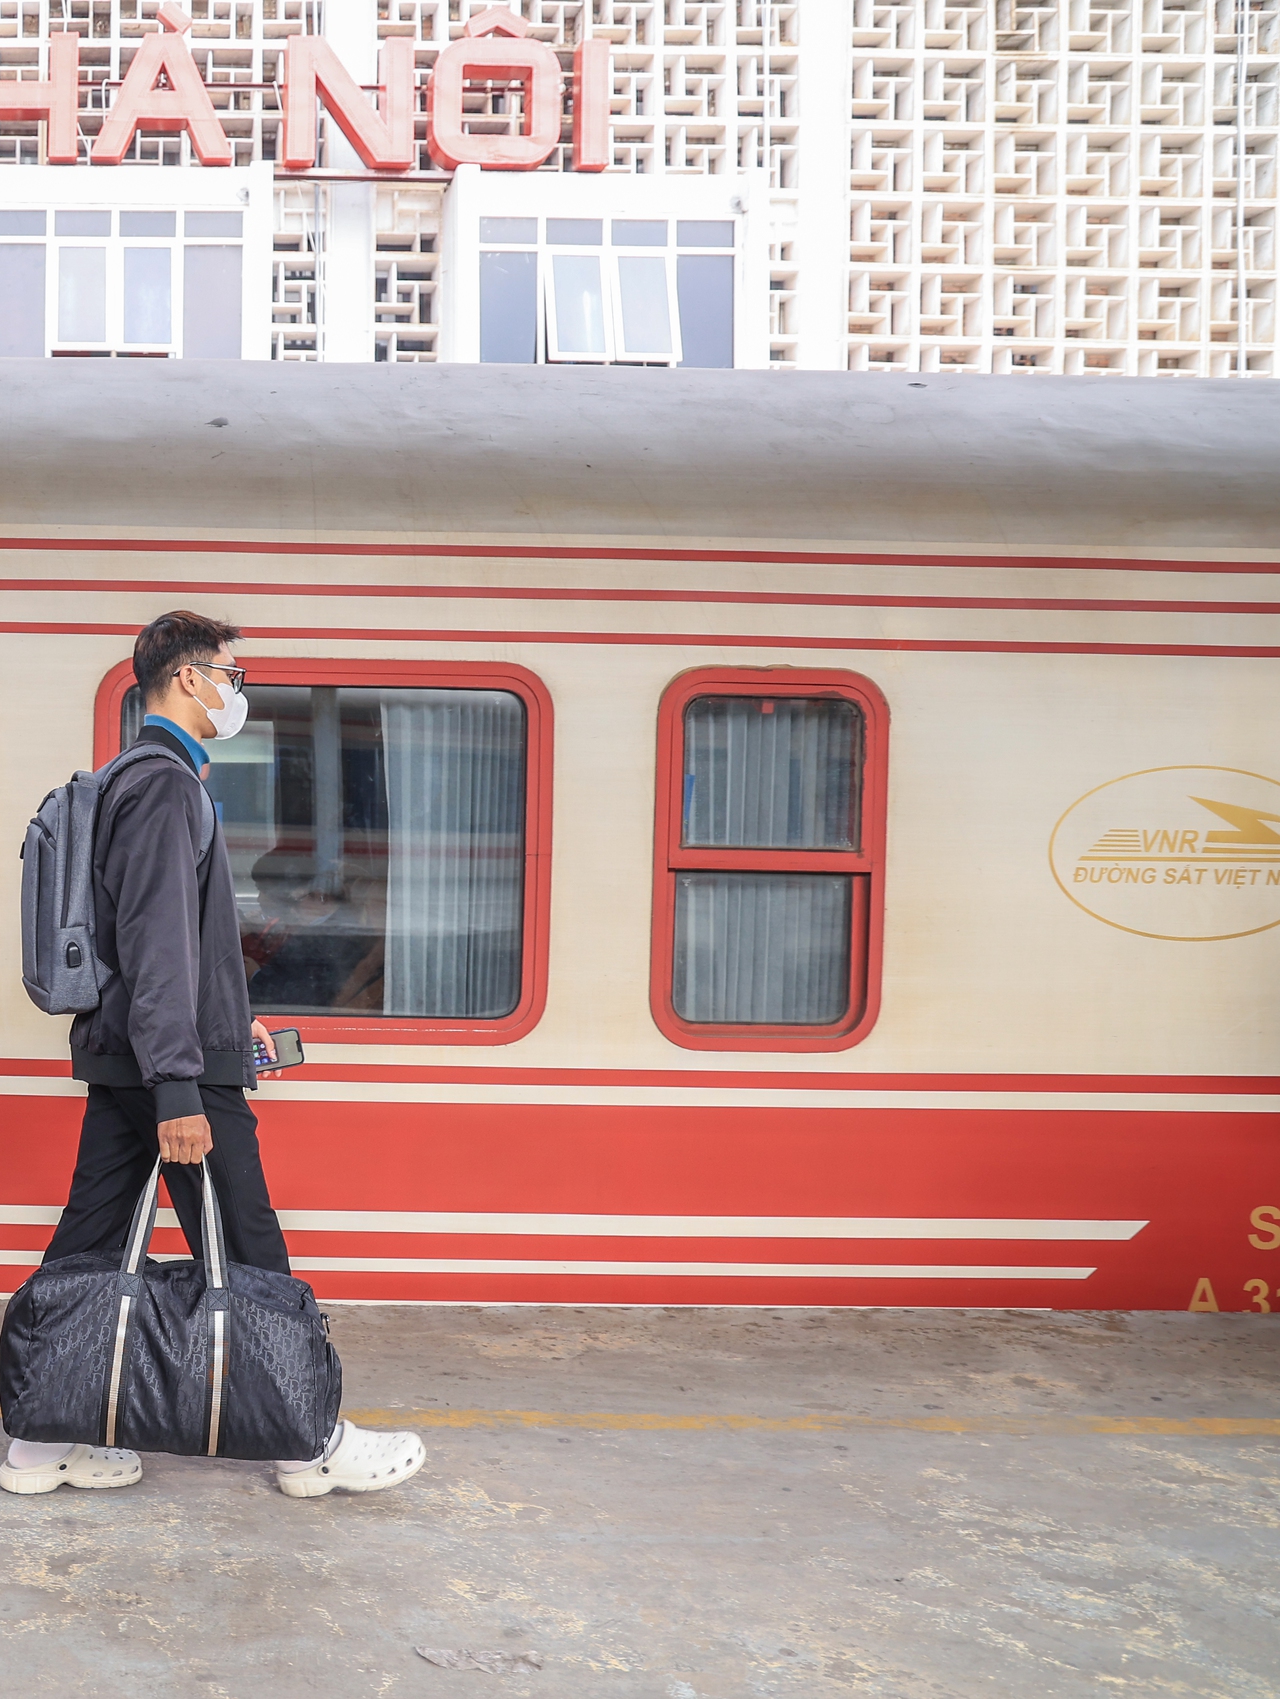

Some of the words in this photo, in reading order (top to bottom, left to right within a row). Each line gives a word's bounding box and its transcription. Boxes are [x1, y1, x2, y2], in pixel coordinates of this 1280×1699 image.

[1141, 829, 1200, 854] VNR
[1073, 863, 1158, 885] ĐƯỜNG
[1213, 866, 1262, 890] VIỆT
[1187, 1277, 1220, 1313] A
[1242, 1278, 1280, 1314] 3
